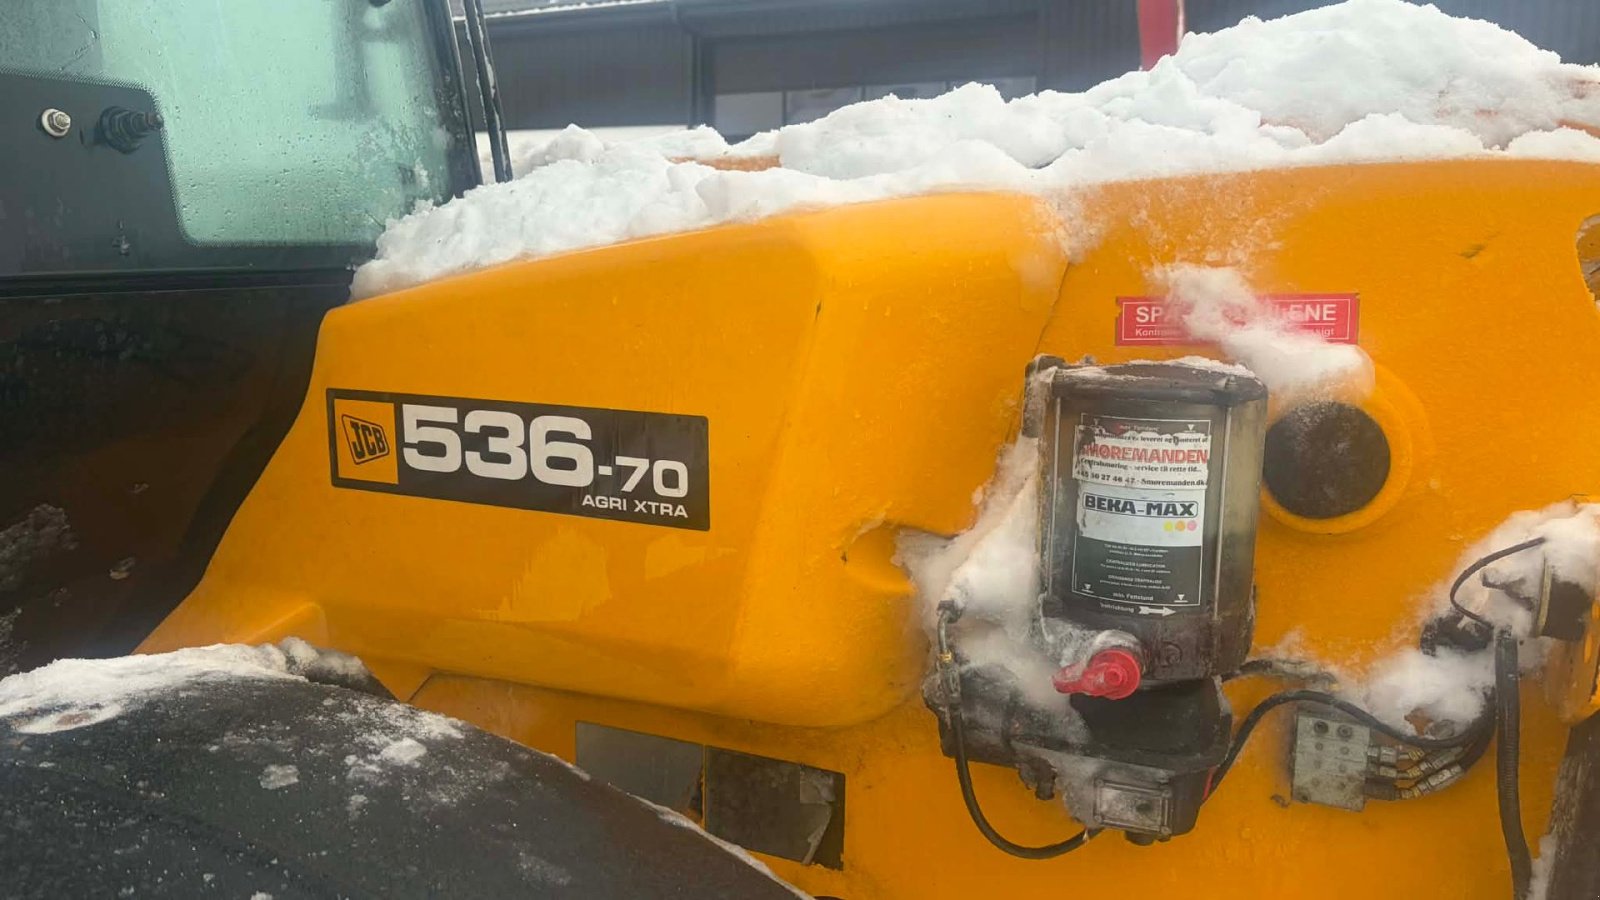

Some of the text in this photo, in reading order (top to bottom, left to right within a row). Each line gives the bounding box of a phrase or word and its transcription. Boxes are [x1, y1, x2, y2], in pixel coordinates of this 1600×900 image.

[350, 421, 386, 458] JCB
[402, 403, 689, 498] 536-70
[581, 494, 689, 519] AGRI XTRA
[1085, 494, 1195, 516] BEKA-MAX
